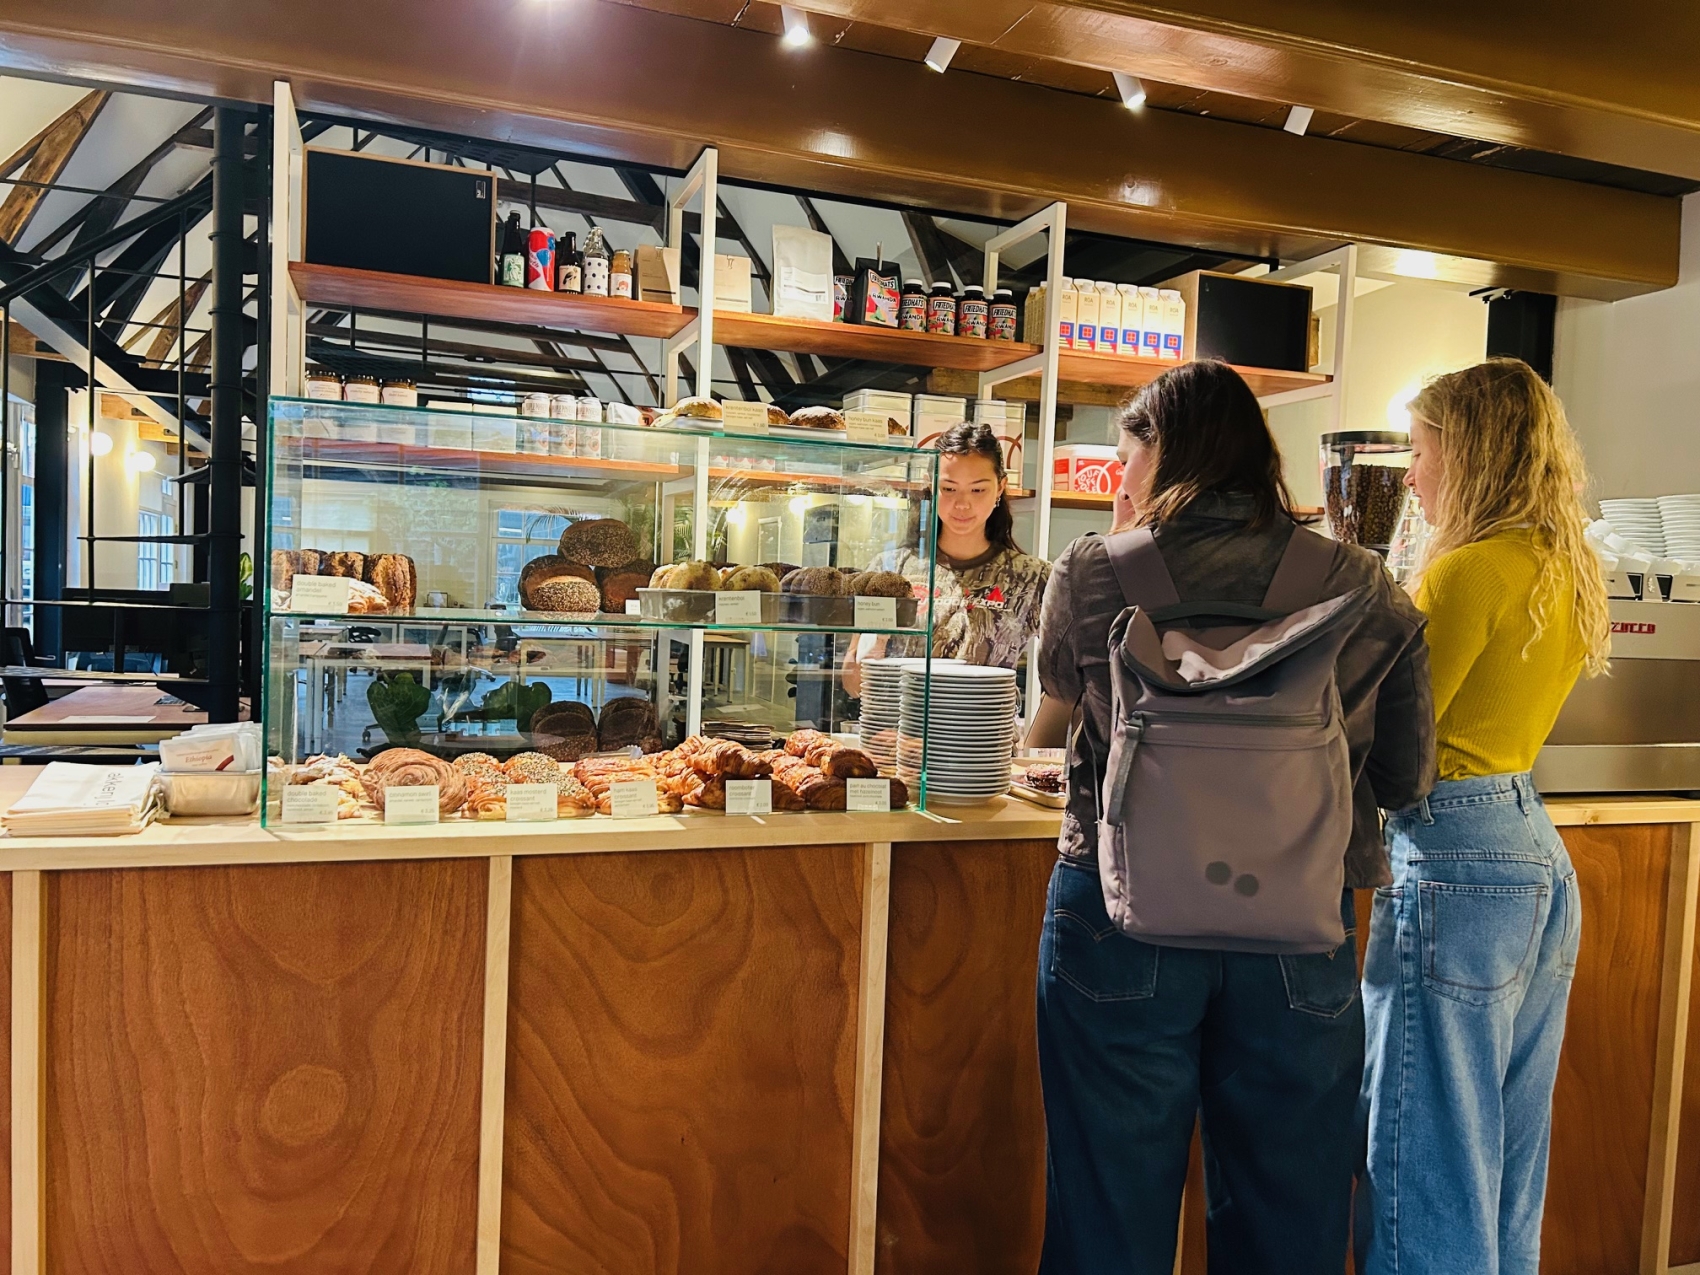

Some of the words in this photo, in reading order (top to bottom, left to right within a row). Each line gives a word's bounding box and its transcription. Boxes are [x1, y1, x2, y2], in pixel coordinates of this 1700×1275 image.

[872, 293, 896, 302] RWANDA
[1084, 296, 1093, 304] ROA
[185, 754, 213, 763] Ethiopia
